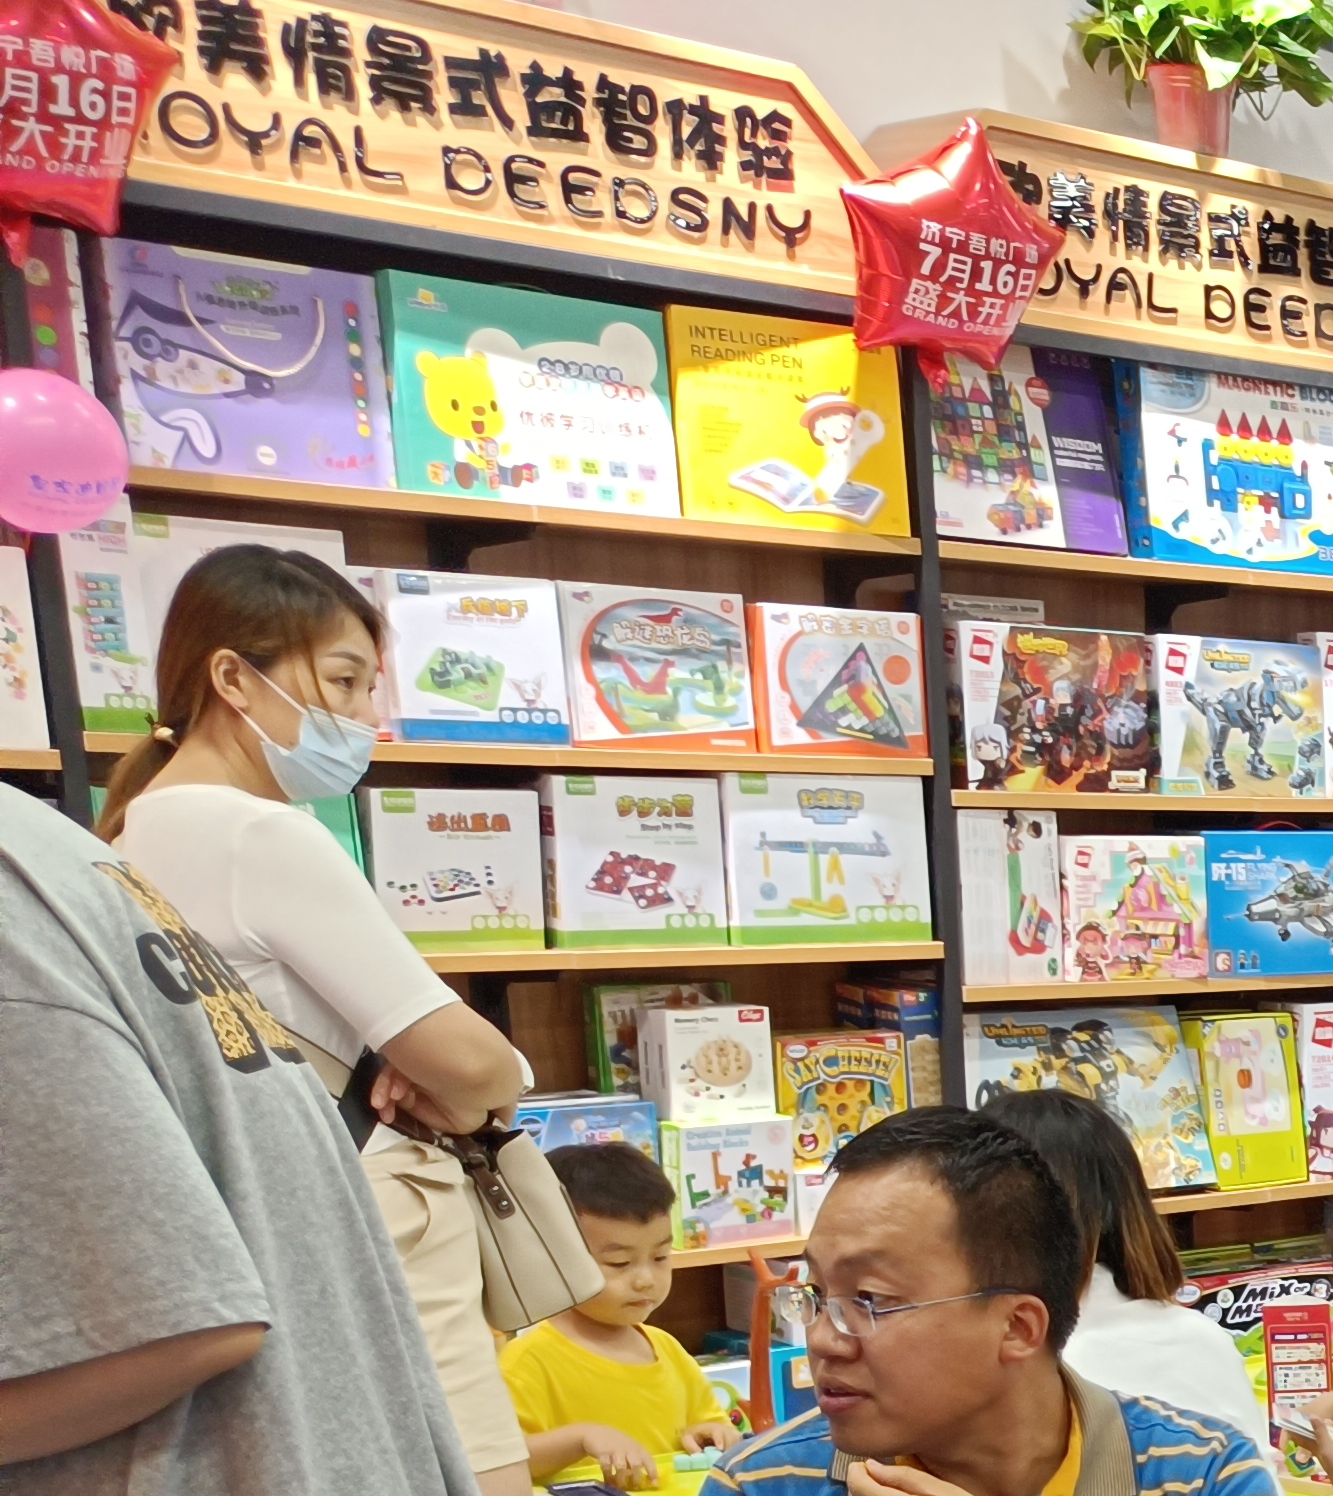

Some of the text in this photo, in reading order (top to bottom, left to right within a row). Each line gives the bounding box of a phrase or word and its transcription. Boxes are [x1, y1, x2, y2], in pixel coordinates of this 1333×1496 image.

[0, 116, 131, 164] 大开业
[141, 89, 812, 250] OYAL DEEDSNY
[919, 243, 1036, 297] 7月16日
[902, 305, 958, 329] GRAND
[904, 278, 1028, 328] 盛大开业
[689, 325, 799, 350] INTELLIGENT
[690, 344, 803, 369] READING PEN
[1216, 374, 1296, 399] MAGNETIC
[782, 1047, 901, 1088] SAY CHEESE!
